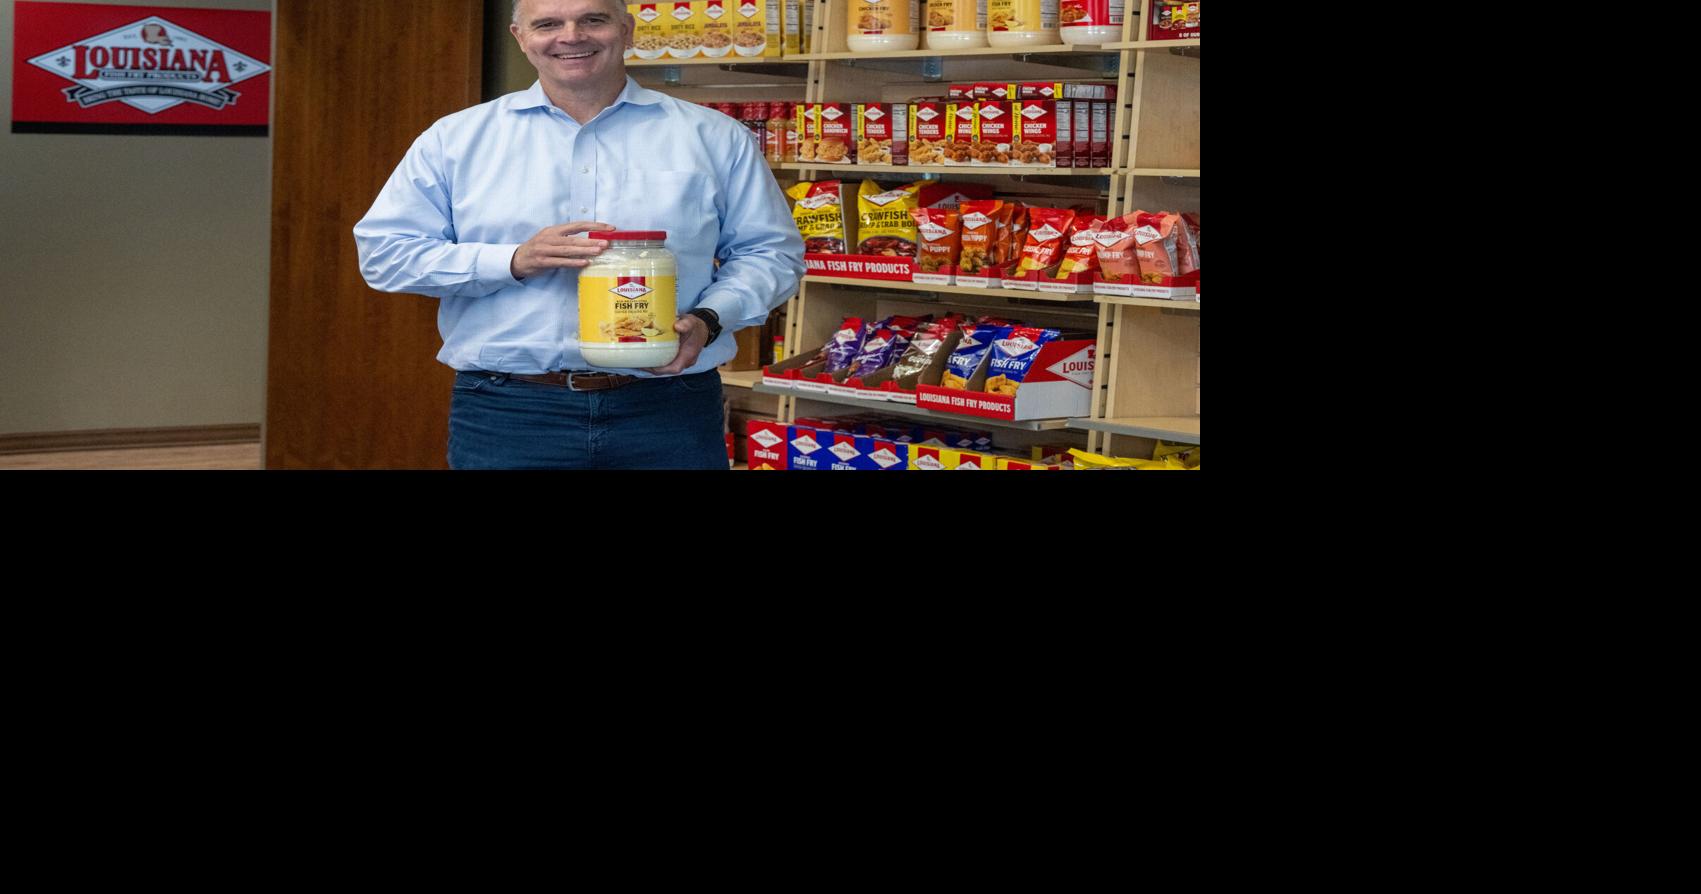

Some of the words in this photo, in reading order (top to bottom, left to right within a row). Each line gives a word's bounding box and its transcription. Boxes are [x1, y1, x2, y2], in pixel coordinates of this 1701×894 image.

[72, 44, 232, 83] LOUISIANA
[860, 210, 908, 221] CRAWFISH
[827, 260, 847, 271] FISH
[847, 261, 863, 272] FRY
[864, 262, 910, 275] PRODUCTS
[952, 356, 971, 366] FRY
[990, 358, 1008, 368] FISH
[1008, 360, 1027, 370] FRY
[1062, 361, 1094, 373] LOUIS
[919, 392, 951, 405] LOUISIANA
[951, 396, 965, 407] FISH
[966, 398, 977, 409] FRY
[978, 400, 1011, 413] PRODUCTS
[754, 449, 767, 458] FISH
[768, 451, 779, 460] FRY
[793, 456, 806, 465] FISH
[807, 458, 818, 467] FRY
